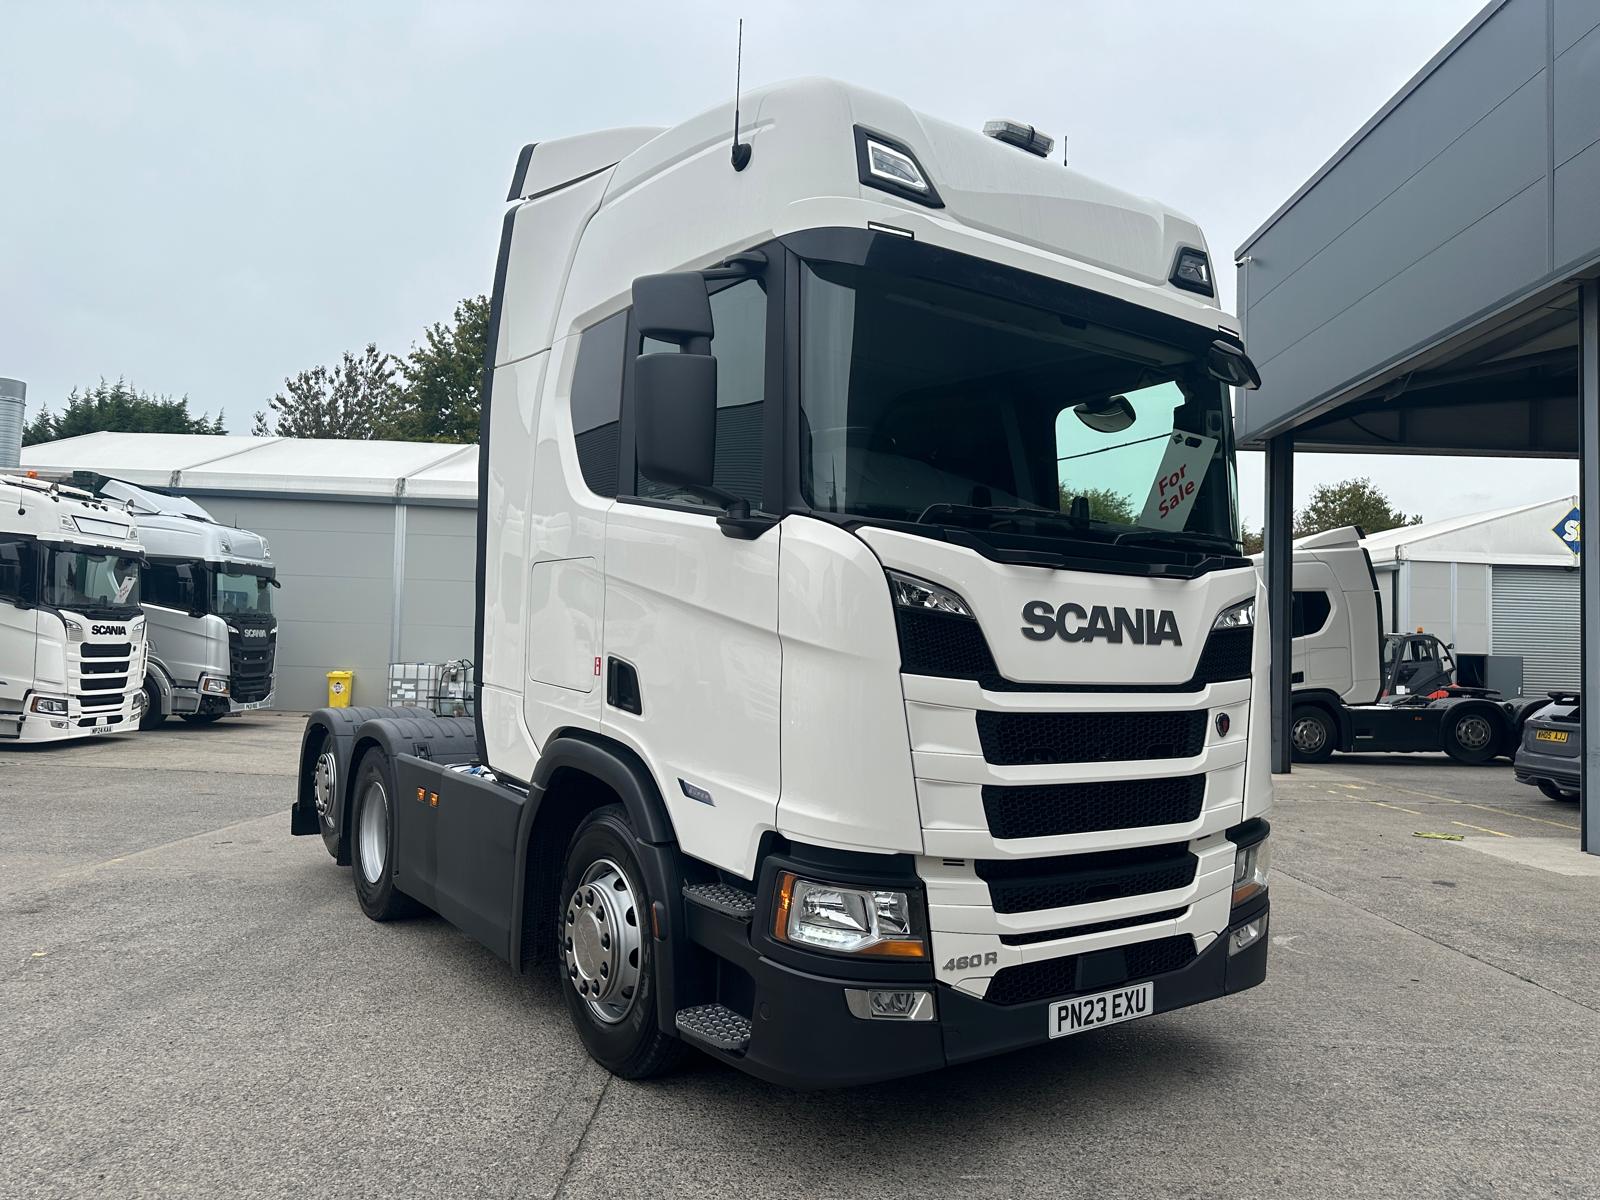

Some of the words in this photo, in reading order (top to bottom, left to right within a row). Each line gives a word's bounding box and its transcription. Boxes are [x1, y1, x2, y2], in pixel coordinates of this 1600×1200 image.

[1158, 464, 1187, 497] For
[1158, 479, 1195, 519] Sale
[92, 625, 126, 636] SCANIA
[244, 629, 267, 638] SCANIA
[1021, 600, 1182, 646] SCANIA
[942, 953, 982, 972] 460
[983, 951, 998, 966] R
[1056, 998, 1107, 1032] PN23
[1112, 987, 1147, 1019] EXU
